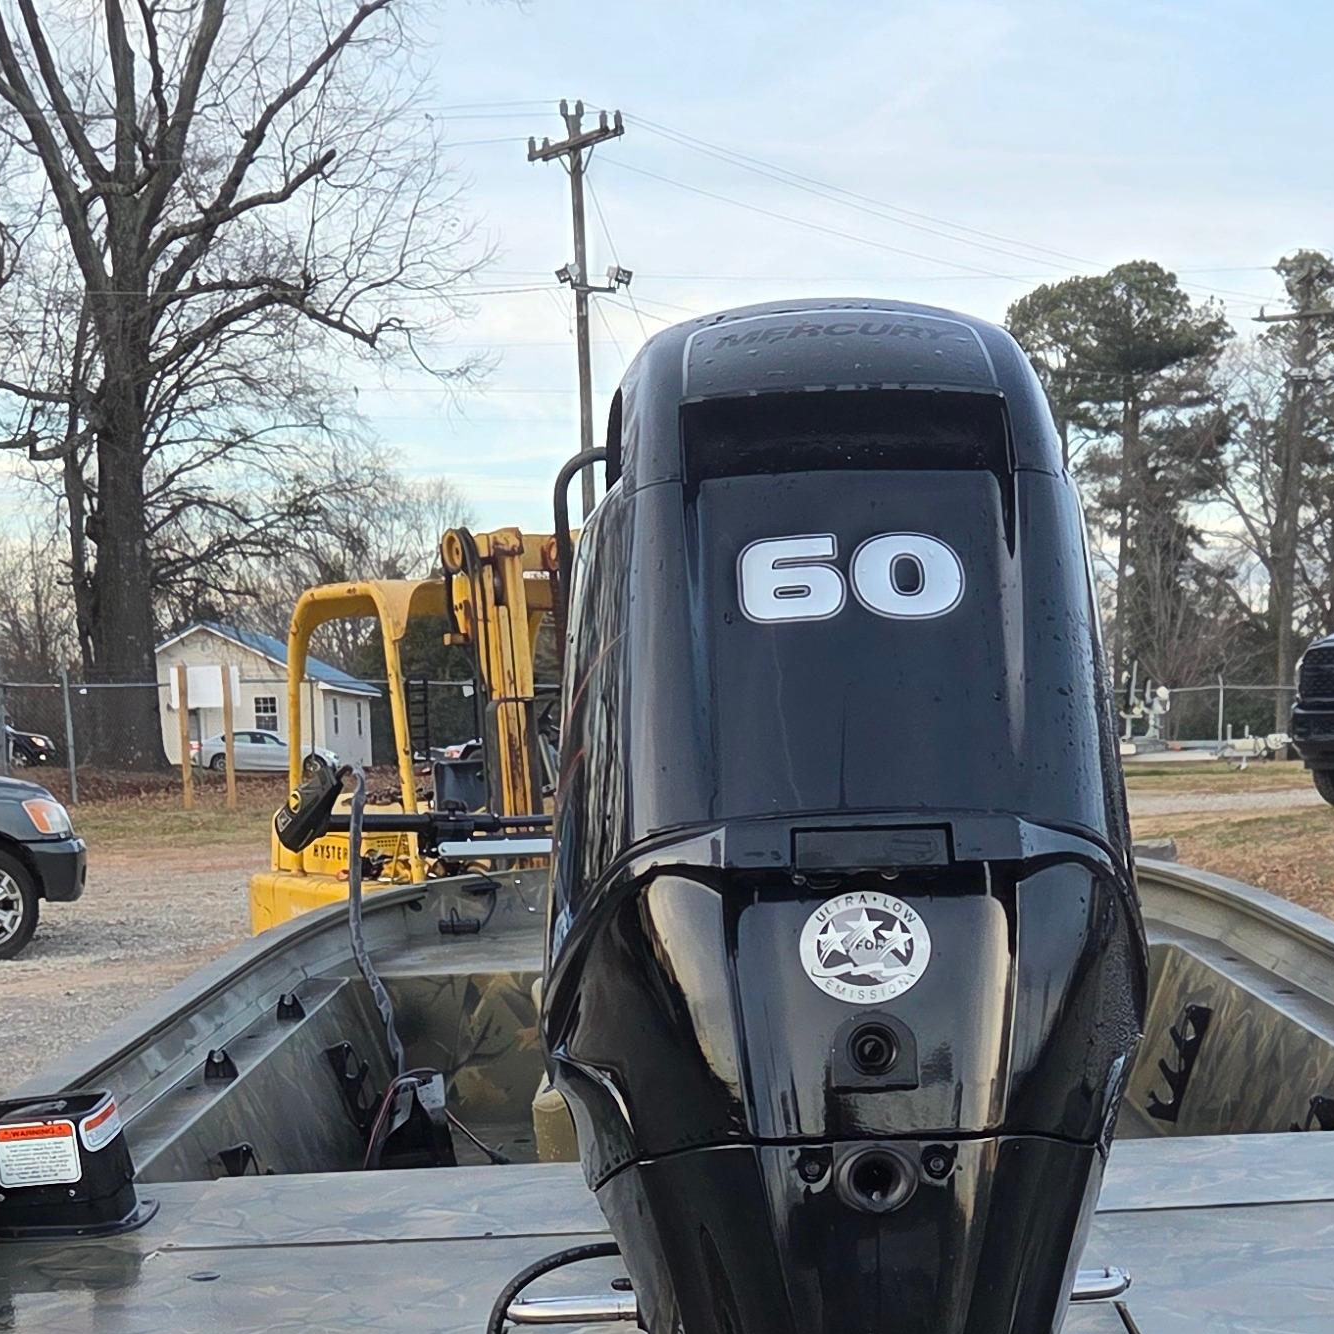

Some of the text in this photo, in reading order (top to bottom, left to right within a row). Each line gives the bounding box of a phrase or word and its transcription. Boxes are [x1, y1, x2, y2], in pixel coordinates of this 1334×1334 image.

[714, 321, 957, 351] MERCURY
[736, 531, 967, 625] 60
[815, 894, 917, 923] ULTRA LOW
[824, 976, 910, 1000] EMISSION
[11, 1127, 55, 1138] WARNING
